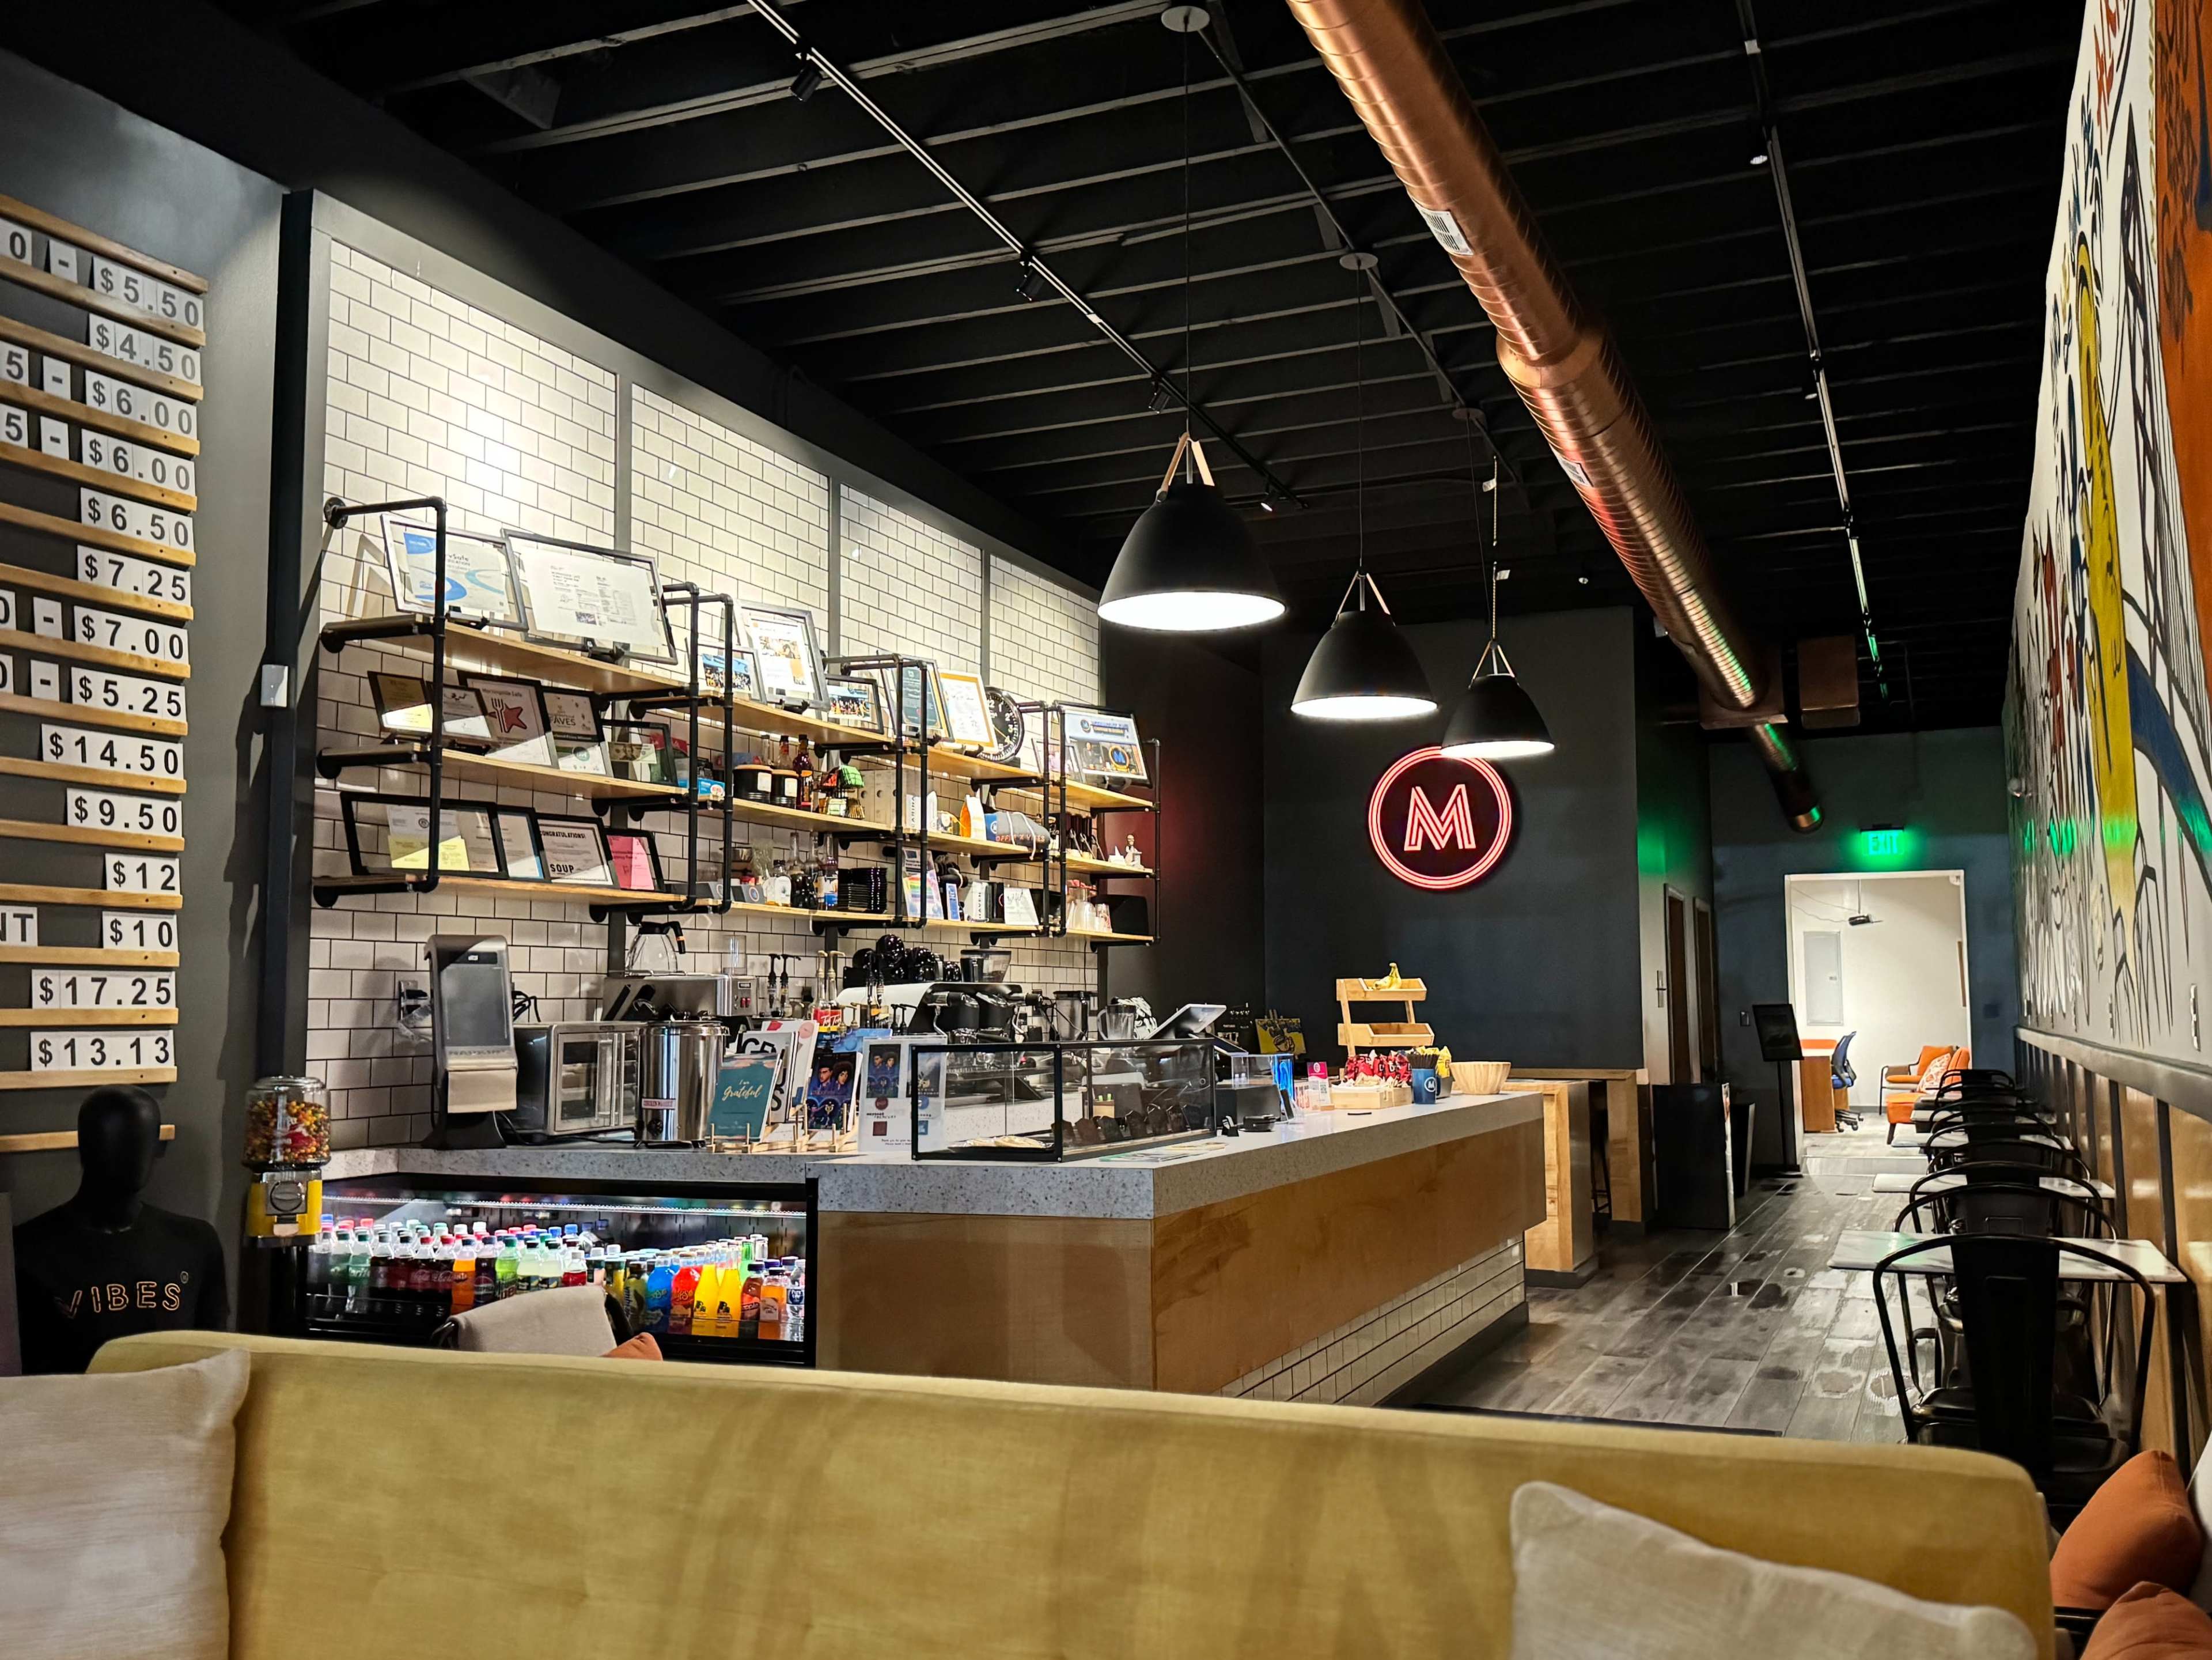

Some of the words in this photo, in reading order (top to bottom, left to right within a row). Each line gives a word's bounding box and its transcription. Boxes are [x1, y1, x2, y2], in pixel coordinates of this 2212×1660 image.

[100, 266, 199, 327] $5.50
[96, 323, 196, 380] $4.50
[6, 352, 24, 380] 5
[92, 379, 192, 435] $6.00
[5, 413, 22, 441] 5
[89, 438, 190, 491] $6.00
[88, 496, 188, 546] $6.50
[85, 553, 186, 601] $7.25
[82, 614, 184, 659] $7.00
[79, 675, 181, 717] $5.25
[550, 714, 577, 727] AVES
[50, 732, 179, 774] $14.50
[74, 796, 177, 833] $9.50
[1404, 784, 1476, 851] M
[1869, 832, 1899, 854] EXIT
[112, 860, 176, 891] $12
[550, 864, 574, 874] SOUP
[109, 918, 173, 948] $10
[39, 976, 171, 1005] $17.25
[38, 1037, 170, 1067] $13.13
[722, 1084, 763, 1101] Grateful
[55, 1281, 181, 1319] VIBES
